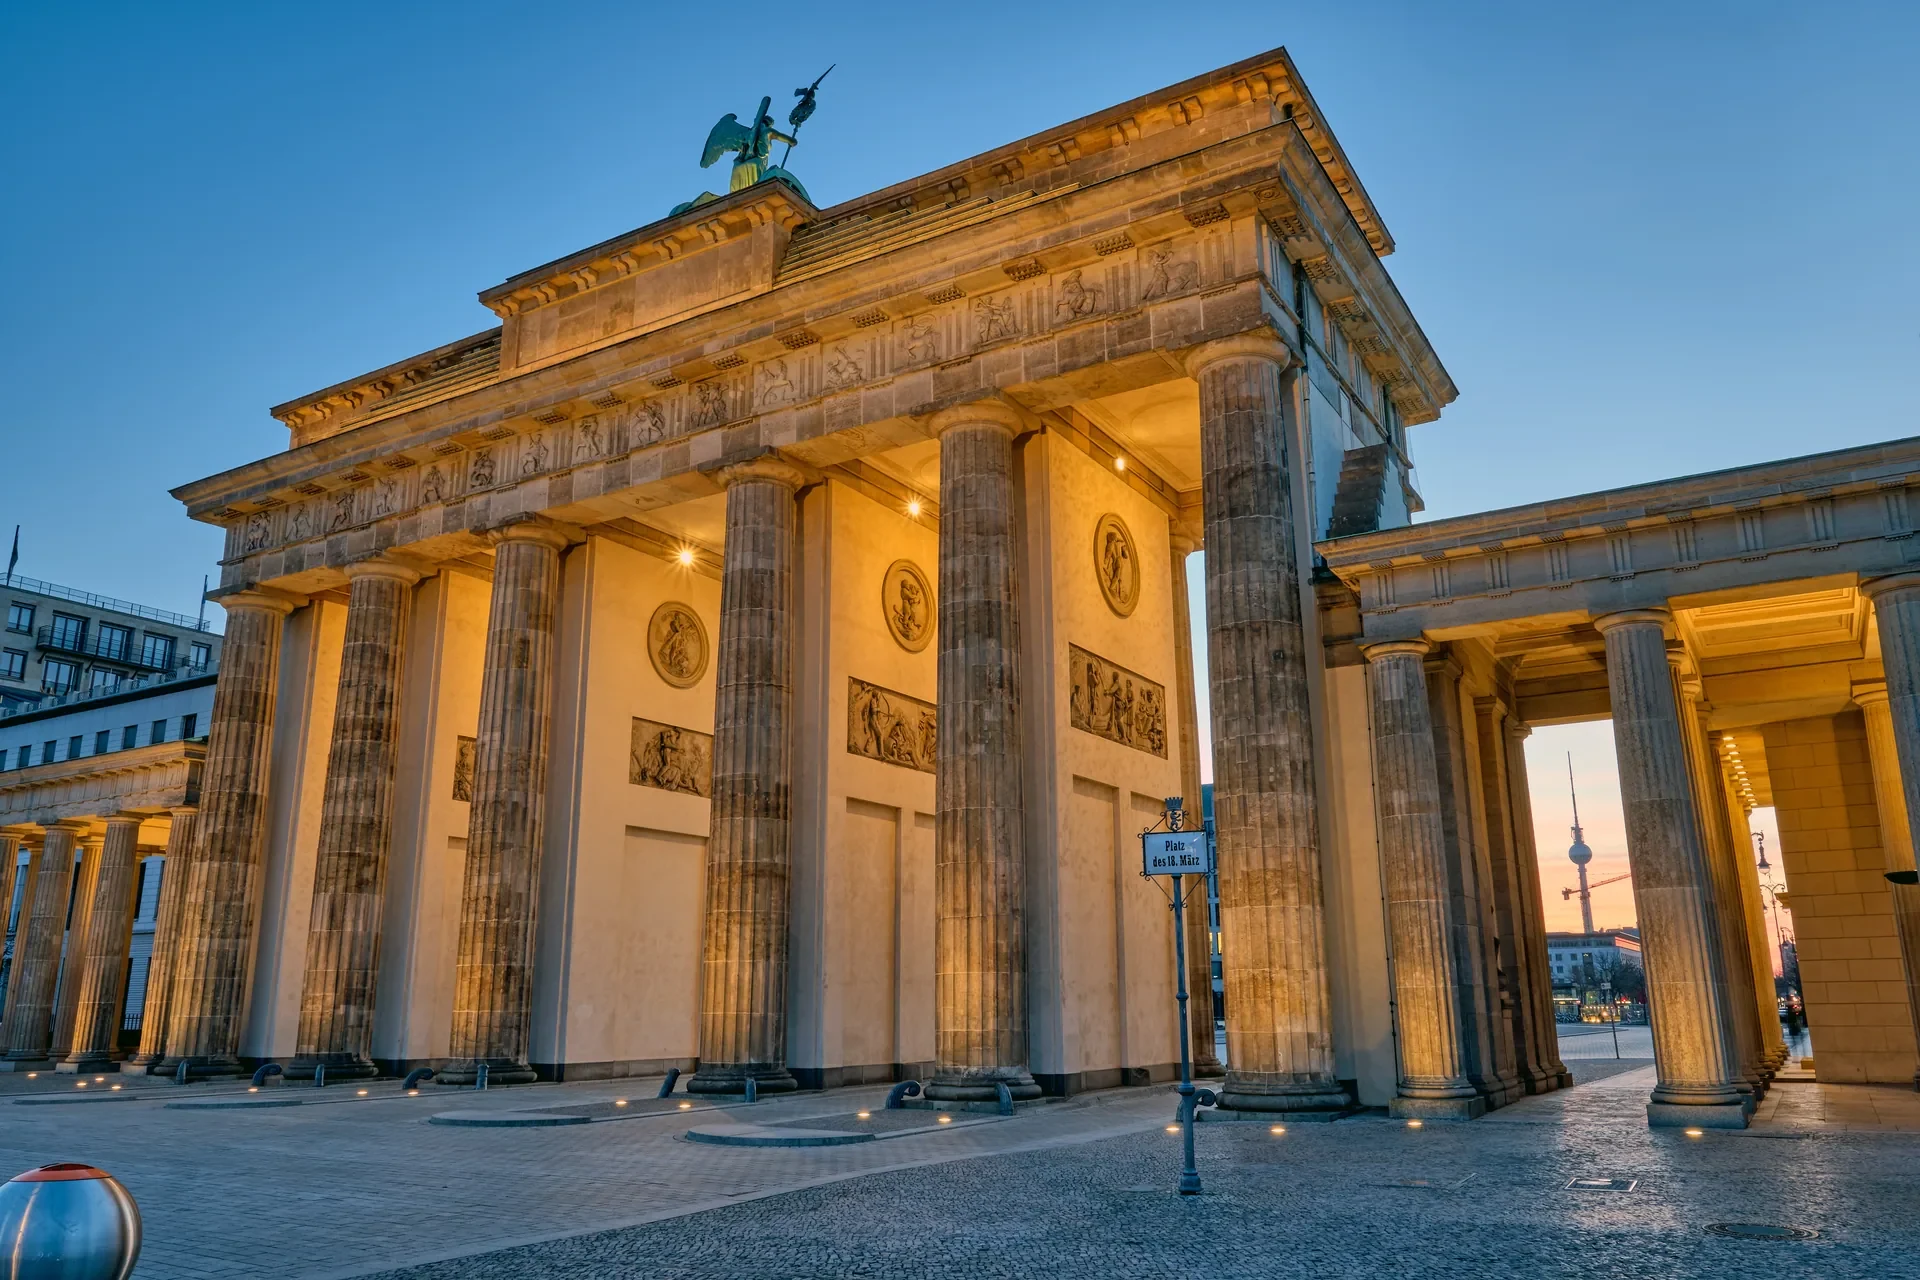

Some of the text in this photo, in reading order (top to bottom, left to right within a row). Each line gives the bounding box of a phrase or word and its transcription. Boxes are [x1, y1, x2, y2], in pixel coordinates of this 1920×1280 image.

[1165, 840, 1185, 851] Platz
[1153, 855, 1200, 867] des 18. März
